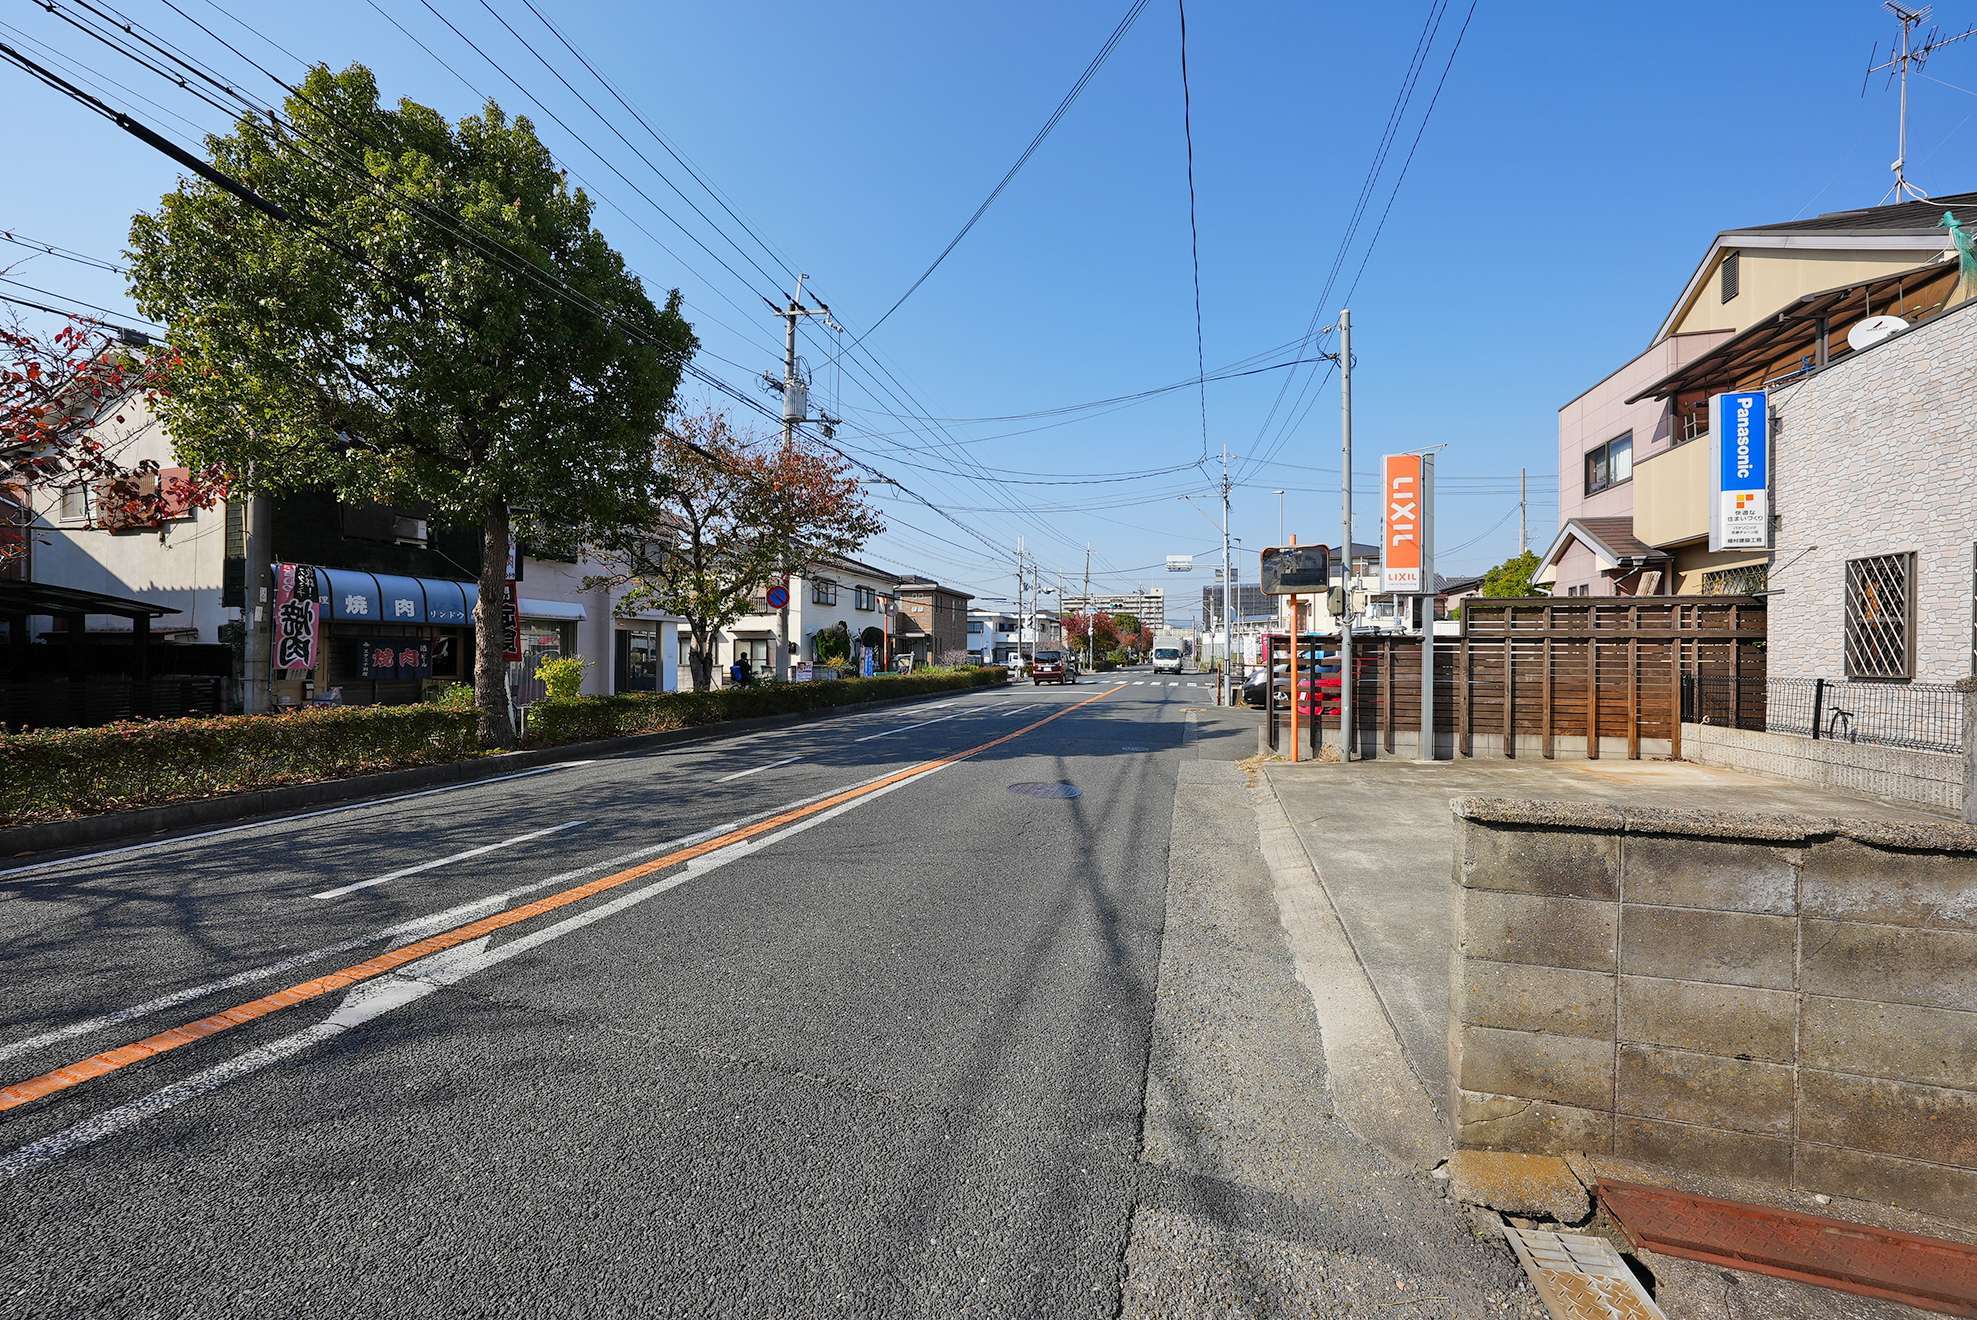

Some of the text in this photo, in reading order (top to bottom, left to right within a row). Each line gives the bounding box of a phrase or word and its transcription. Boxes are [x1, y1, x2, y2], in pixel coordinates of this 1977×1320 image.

[1736, 397, 1753, 479] Panasonic
[1390, 477, 1416, 547] LIXIL
[1388, 572, 1416, 581] LIXIL
[345, 594, 415, 617] 焼肉
[430, 610, 465, 619] リンドウ
[372, 647, 420, 668] 焼肉
